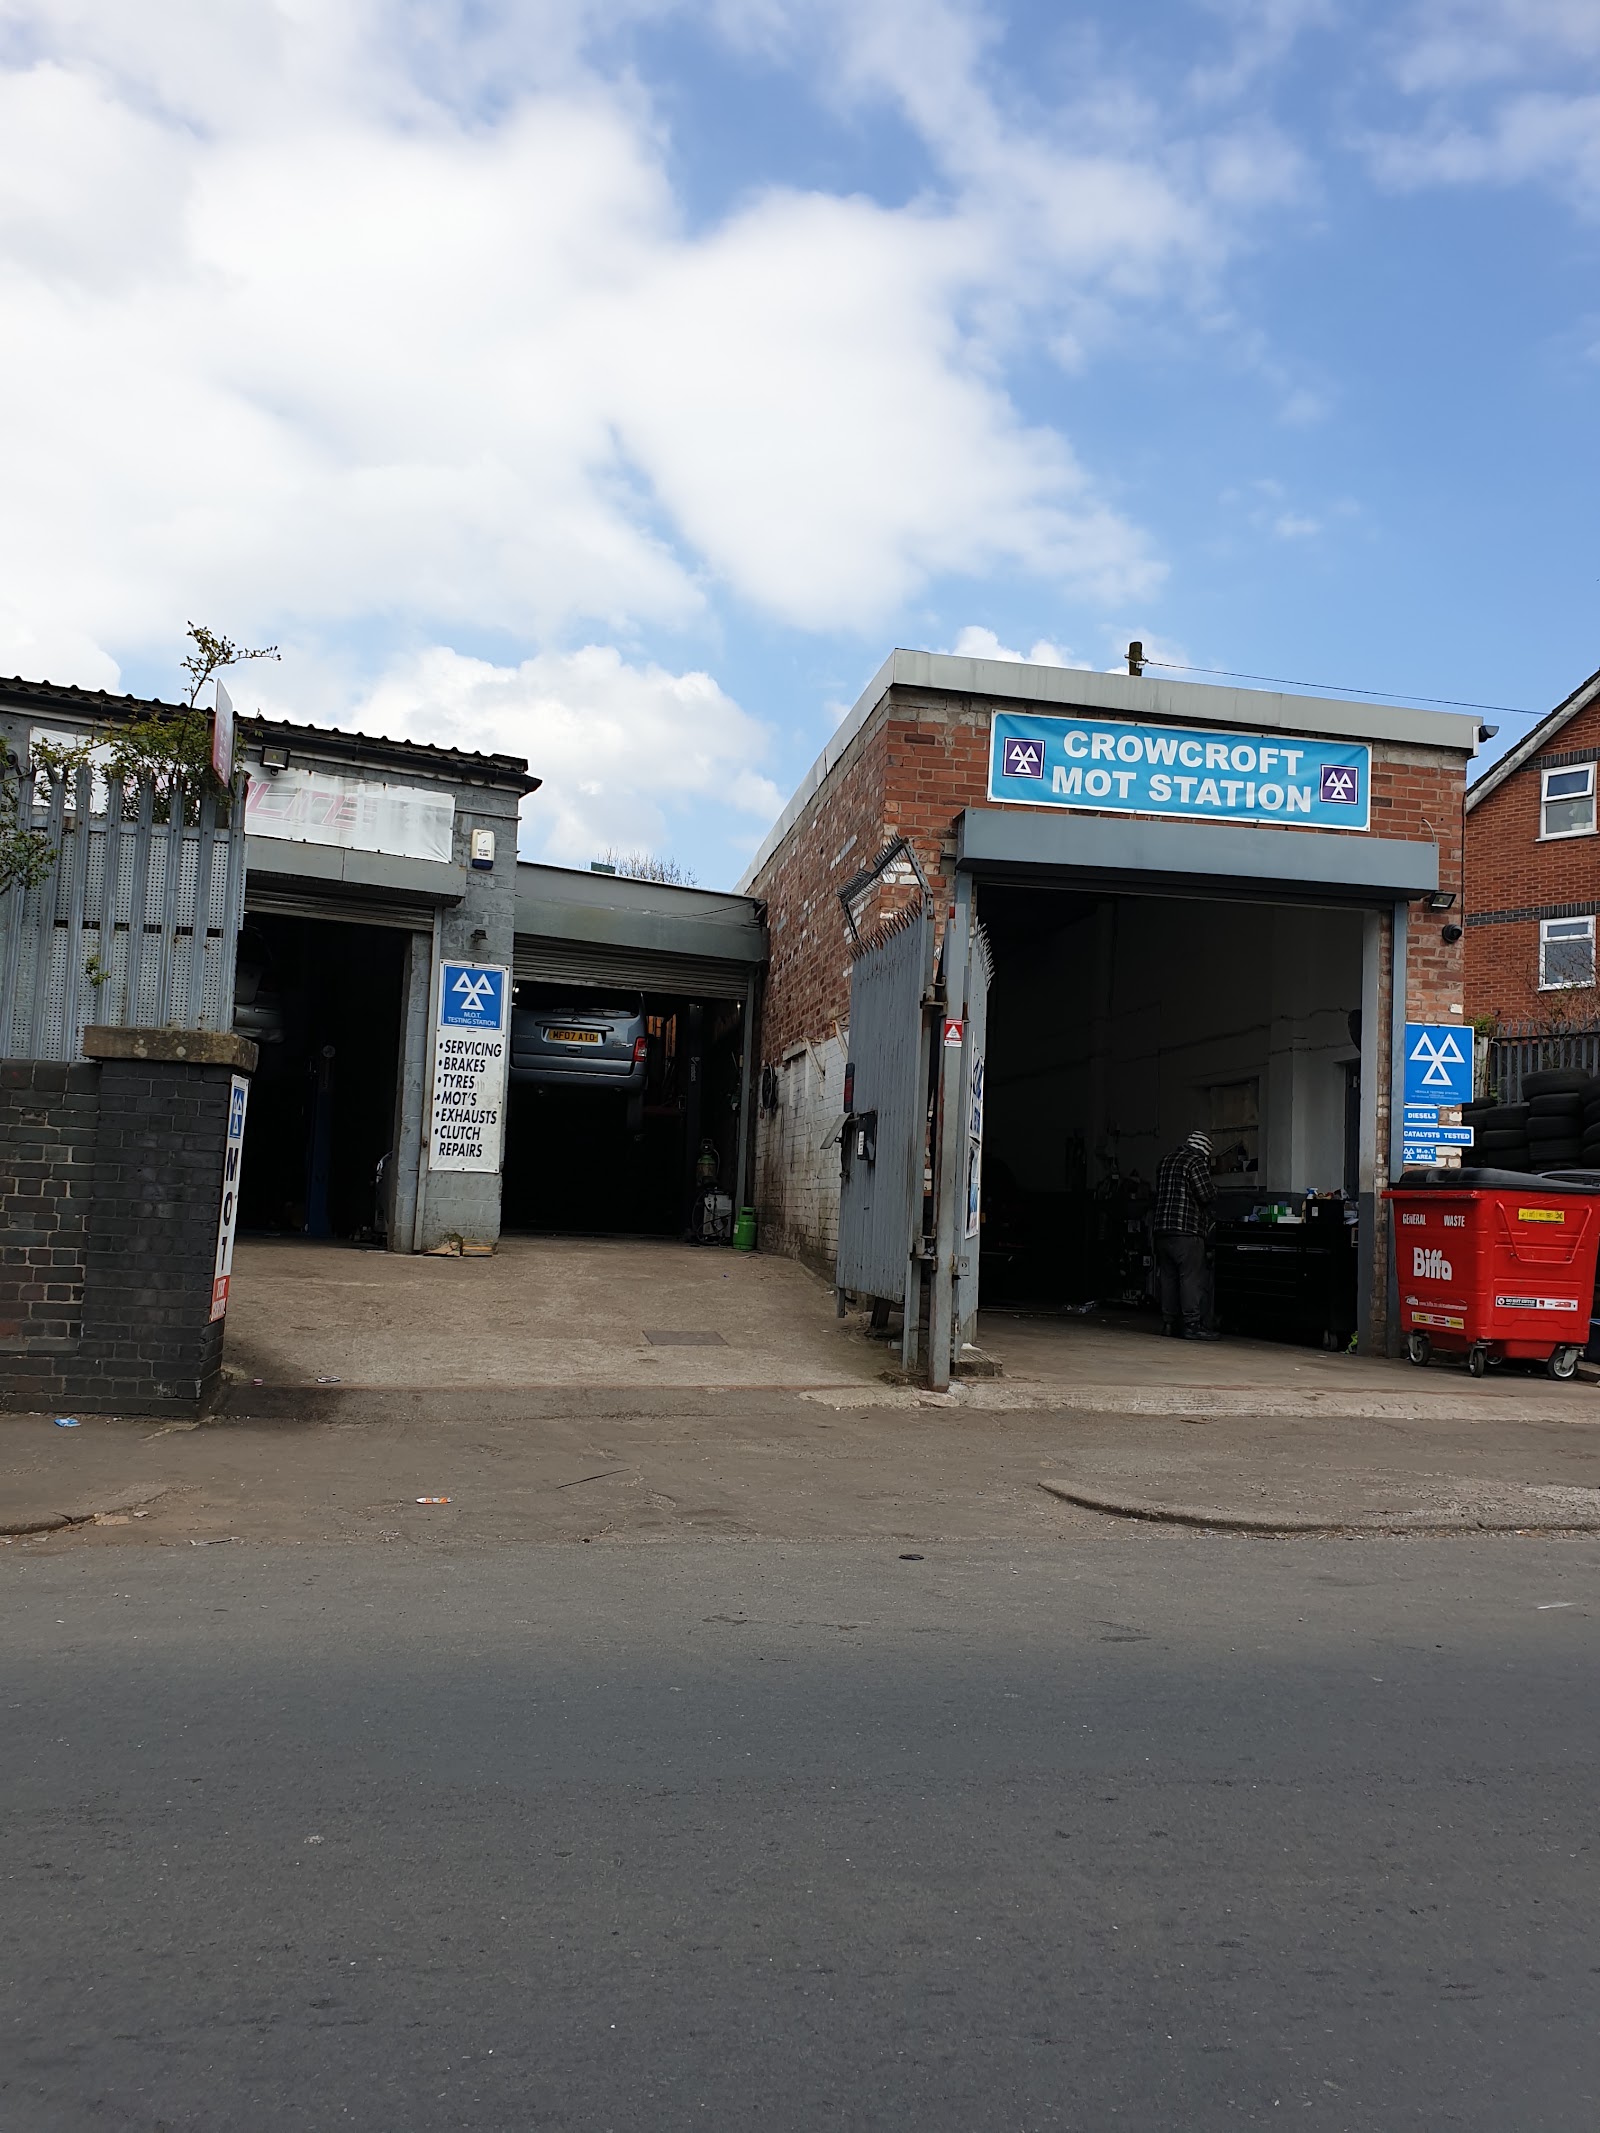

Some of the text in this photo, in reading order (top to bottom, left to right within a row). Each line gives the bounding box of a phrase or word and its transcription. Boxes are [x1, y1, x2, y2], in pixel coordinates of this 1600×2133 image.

[1063, 730, 1303, 776] CROWCROFT
[1052, 765, 1312, 813] MOT STATION
[448, 1016, 472, 1024] TESTING
[444, 1040, 502, 1057] SERVICING
[443, 1057, 486, 1073] BRAKES
[443, 1073, 475, 1089] TYRES
[441, 1091, 477, 1106] MOT'S
[440, 1108, 497, 1124] EXHAUSTS
[440, 1125, 481, 1140] CLUTCH
[1404, 1130, 1440, 1138] CATALYSTS
[439, 1142, 482, 1157] REPAIRS
[1402, 1213, 1465, 1227] GENERAL WASTE
[1413, 1247, 1452, 1281] Biffa
